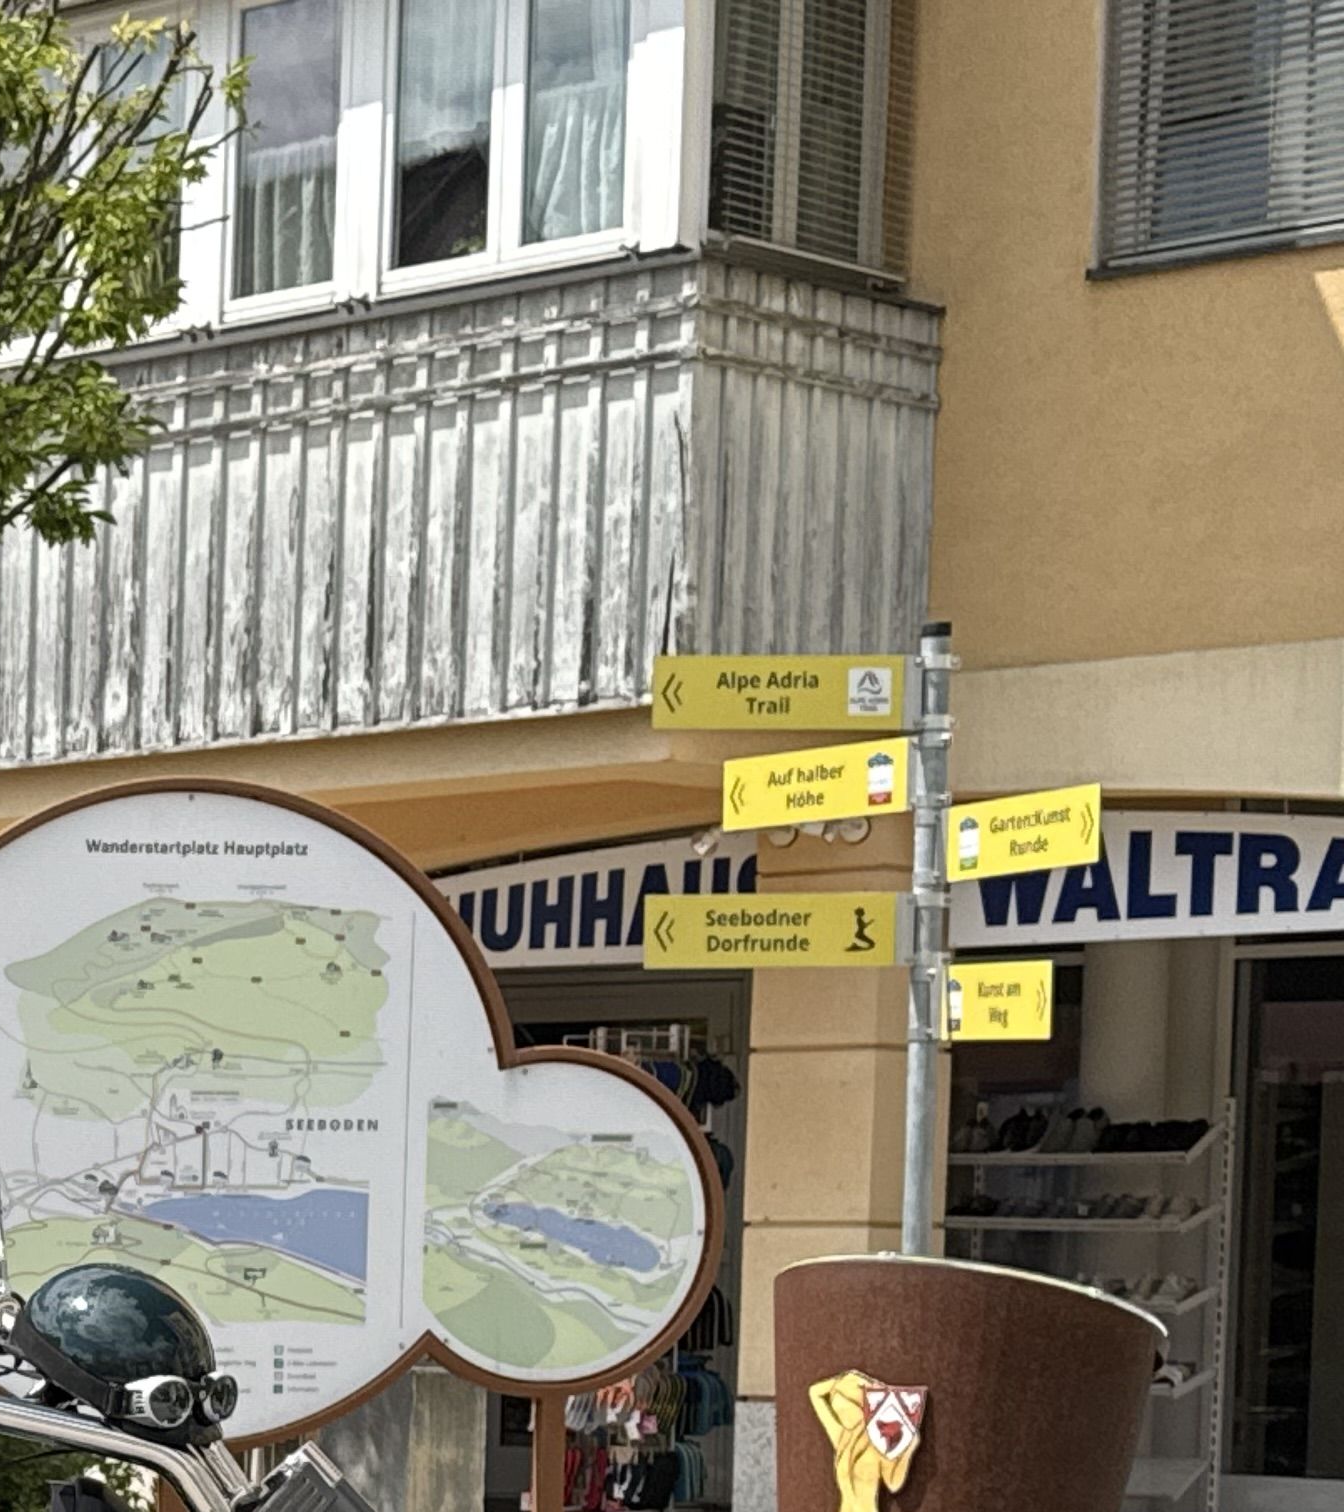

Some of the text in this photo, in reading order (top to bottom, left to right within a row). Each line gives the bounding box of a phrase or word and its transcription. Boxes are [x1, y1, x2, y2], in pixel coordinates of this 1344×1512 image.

[716, 670, 819, 694] Alpe Adria
[745, 696, 791, 715] Trail
[767, 764, 845, 788] Auf halber
[786, 790, 825, 810] Höhe
[85, 838, 309, 858] Wanderstartplatz Hauptplatz
[1009, 834, 1049, 856] Runde
[705, 908, 812, 927] Seebodner
[706, 934, 810, 952] Dorfrunde
[285, 1118, 379, 1132] SEEBODEN
